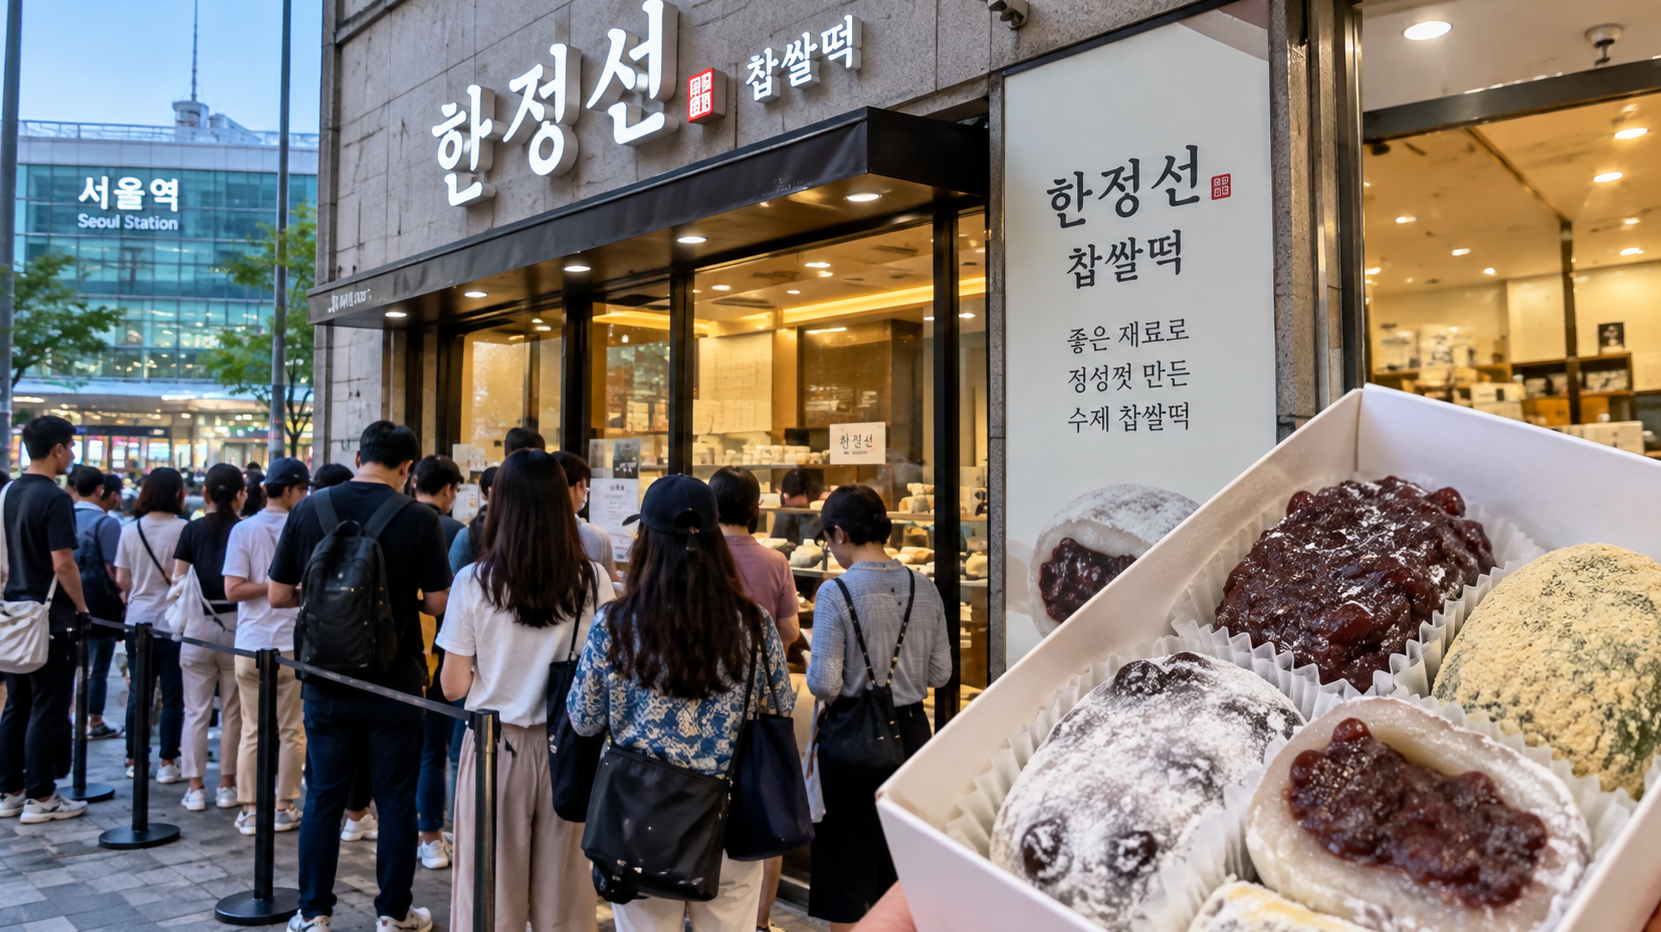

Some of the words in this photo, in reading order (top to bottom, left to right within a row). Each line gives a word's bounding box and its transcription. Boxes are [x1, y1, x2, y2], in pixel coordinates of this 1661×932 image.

[432, 0, 665, 207] 한정선
[745, 14, 853, 101] 찹쌀떡
[78, 176, 178, 212] 서울역
[1046, 144, 1200, 229] 한정선
[78, 213, 120, 229] Seoul
[124, 214, 178, 230] Station
[1066, 229, 1181, 289] 찹쌀떡
[1067, 325, 1110, 354] 좋은
[1118, 318, 1189, 348] 재료로
[1143, 360, 1190, 389] 만든
[1068, 406, 1110, 433] 수제
[1119, 402, 1189, 432] 찹쌀떡
